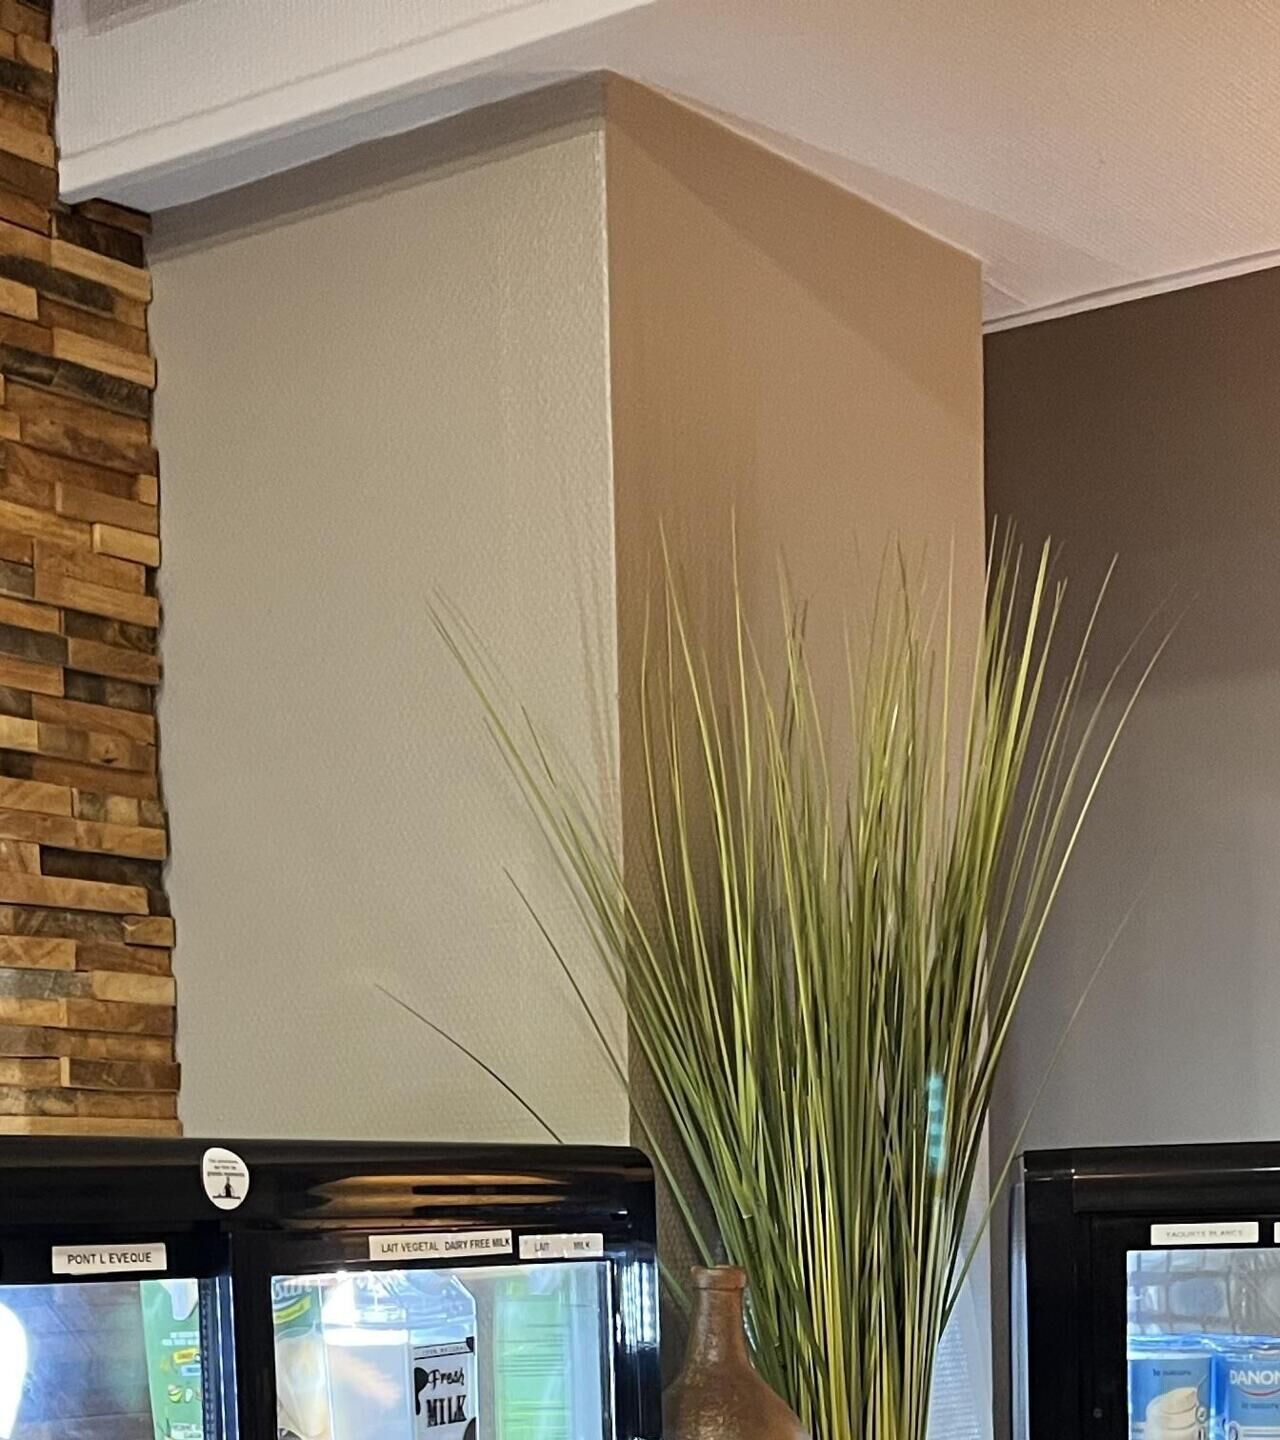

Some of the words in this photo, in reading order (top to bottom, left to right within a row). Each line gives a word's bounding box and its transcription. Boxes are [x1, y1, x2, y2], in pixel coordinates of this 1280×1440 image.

[381, 1243, 399, 1254] LAIT
[401, 1241, 439, 1253] VEGETAL
[444, 1240, 469, 1251] DAIRY
[470, 1239, 490, 1249] FREE
[492, 1237, 511, 1248] MILK
[534, 1242, 550, 1253] LAIT
[67, 1252, 98, 1266] PONT
[108, 1250, 153, 1266] EVEQUE
[427, 1367, 465, 1390] Fresh
[426, 1394, 467, 1428] MILK
